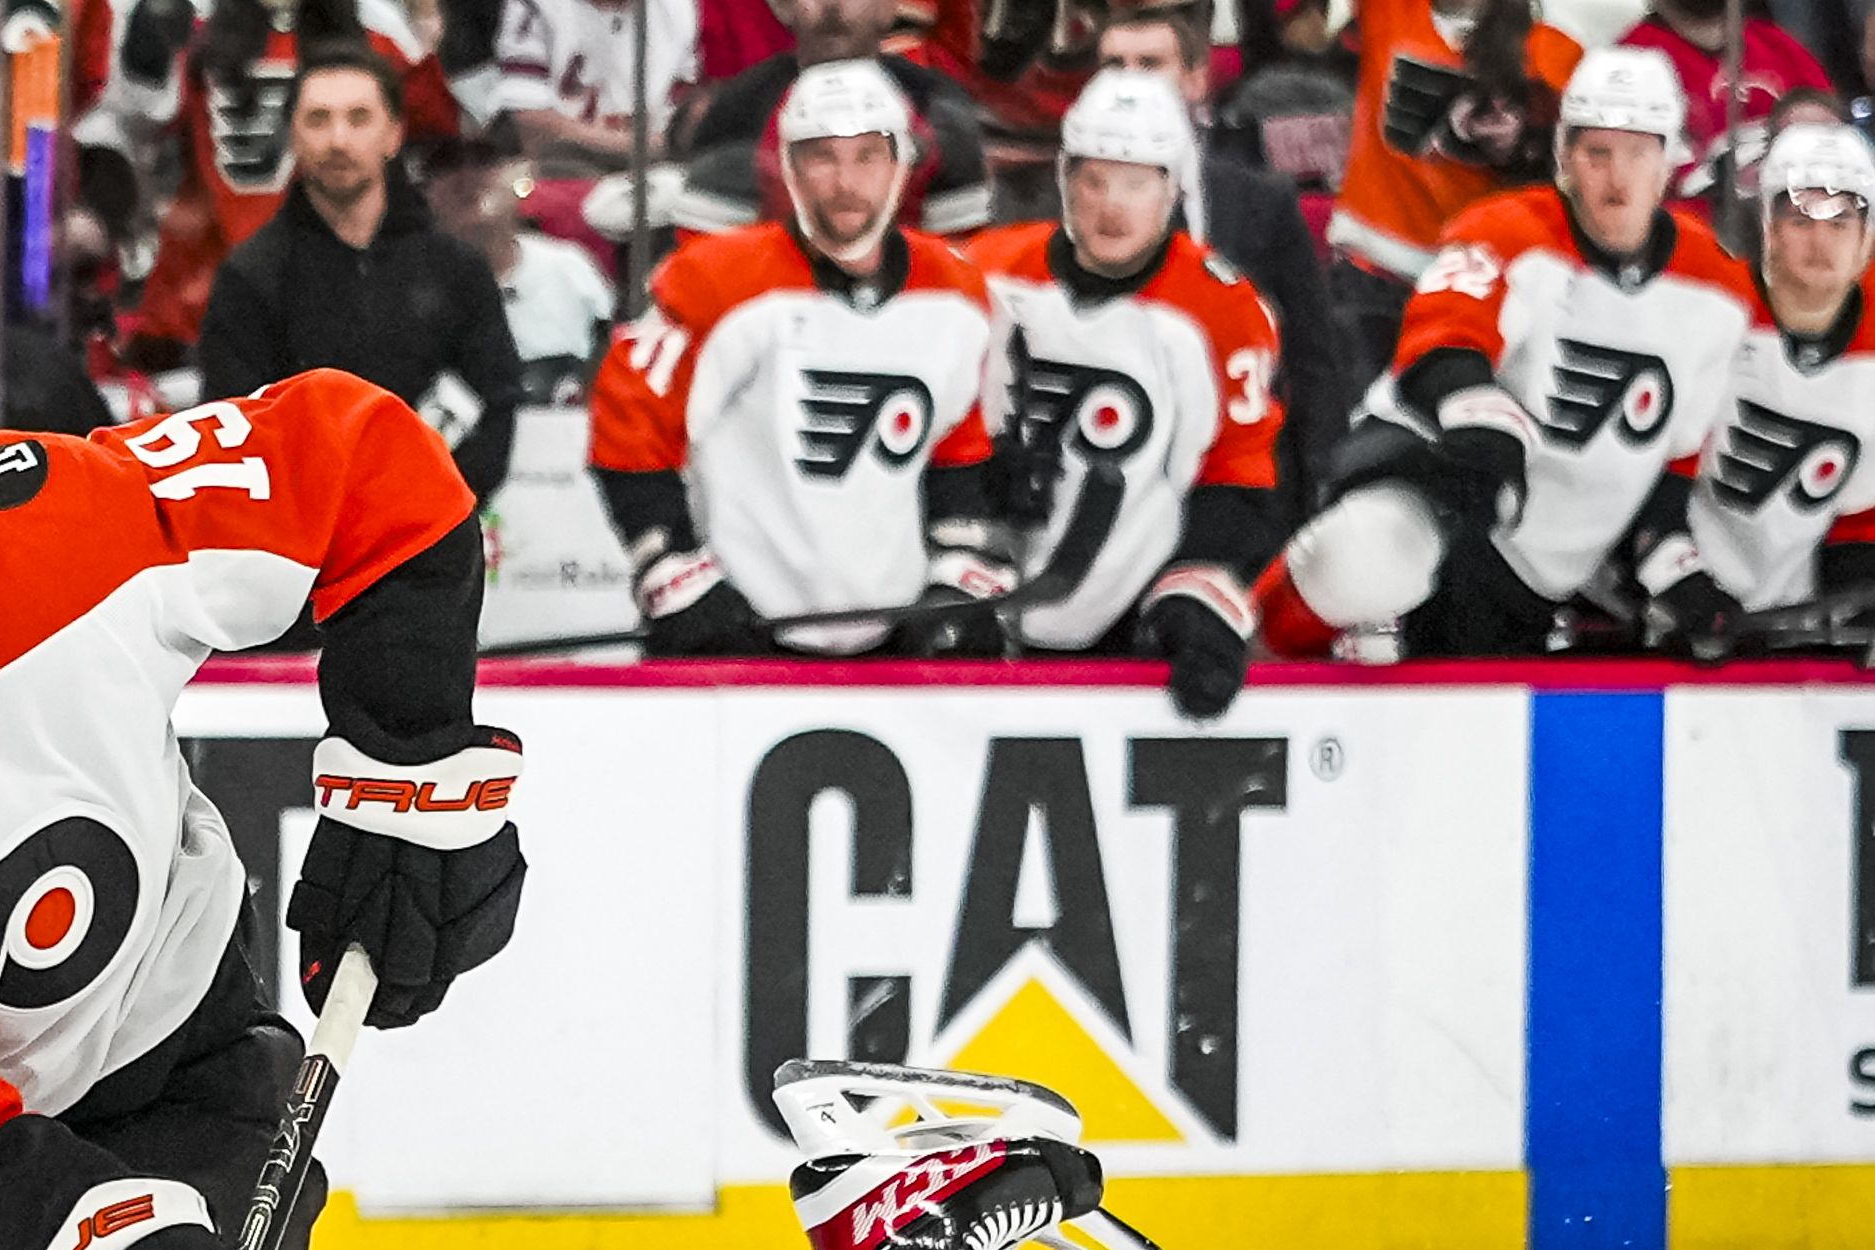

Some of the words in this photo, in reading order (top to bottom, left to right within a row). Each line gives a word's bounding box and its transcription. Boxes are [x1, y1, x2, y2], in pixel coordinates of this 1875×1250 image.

[125, 401, 270, 501] 19
[315, 774, 519, 812] TRUE
[743, 729, 1289, 1147] CAT
